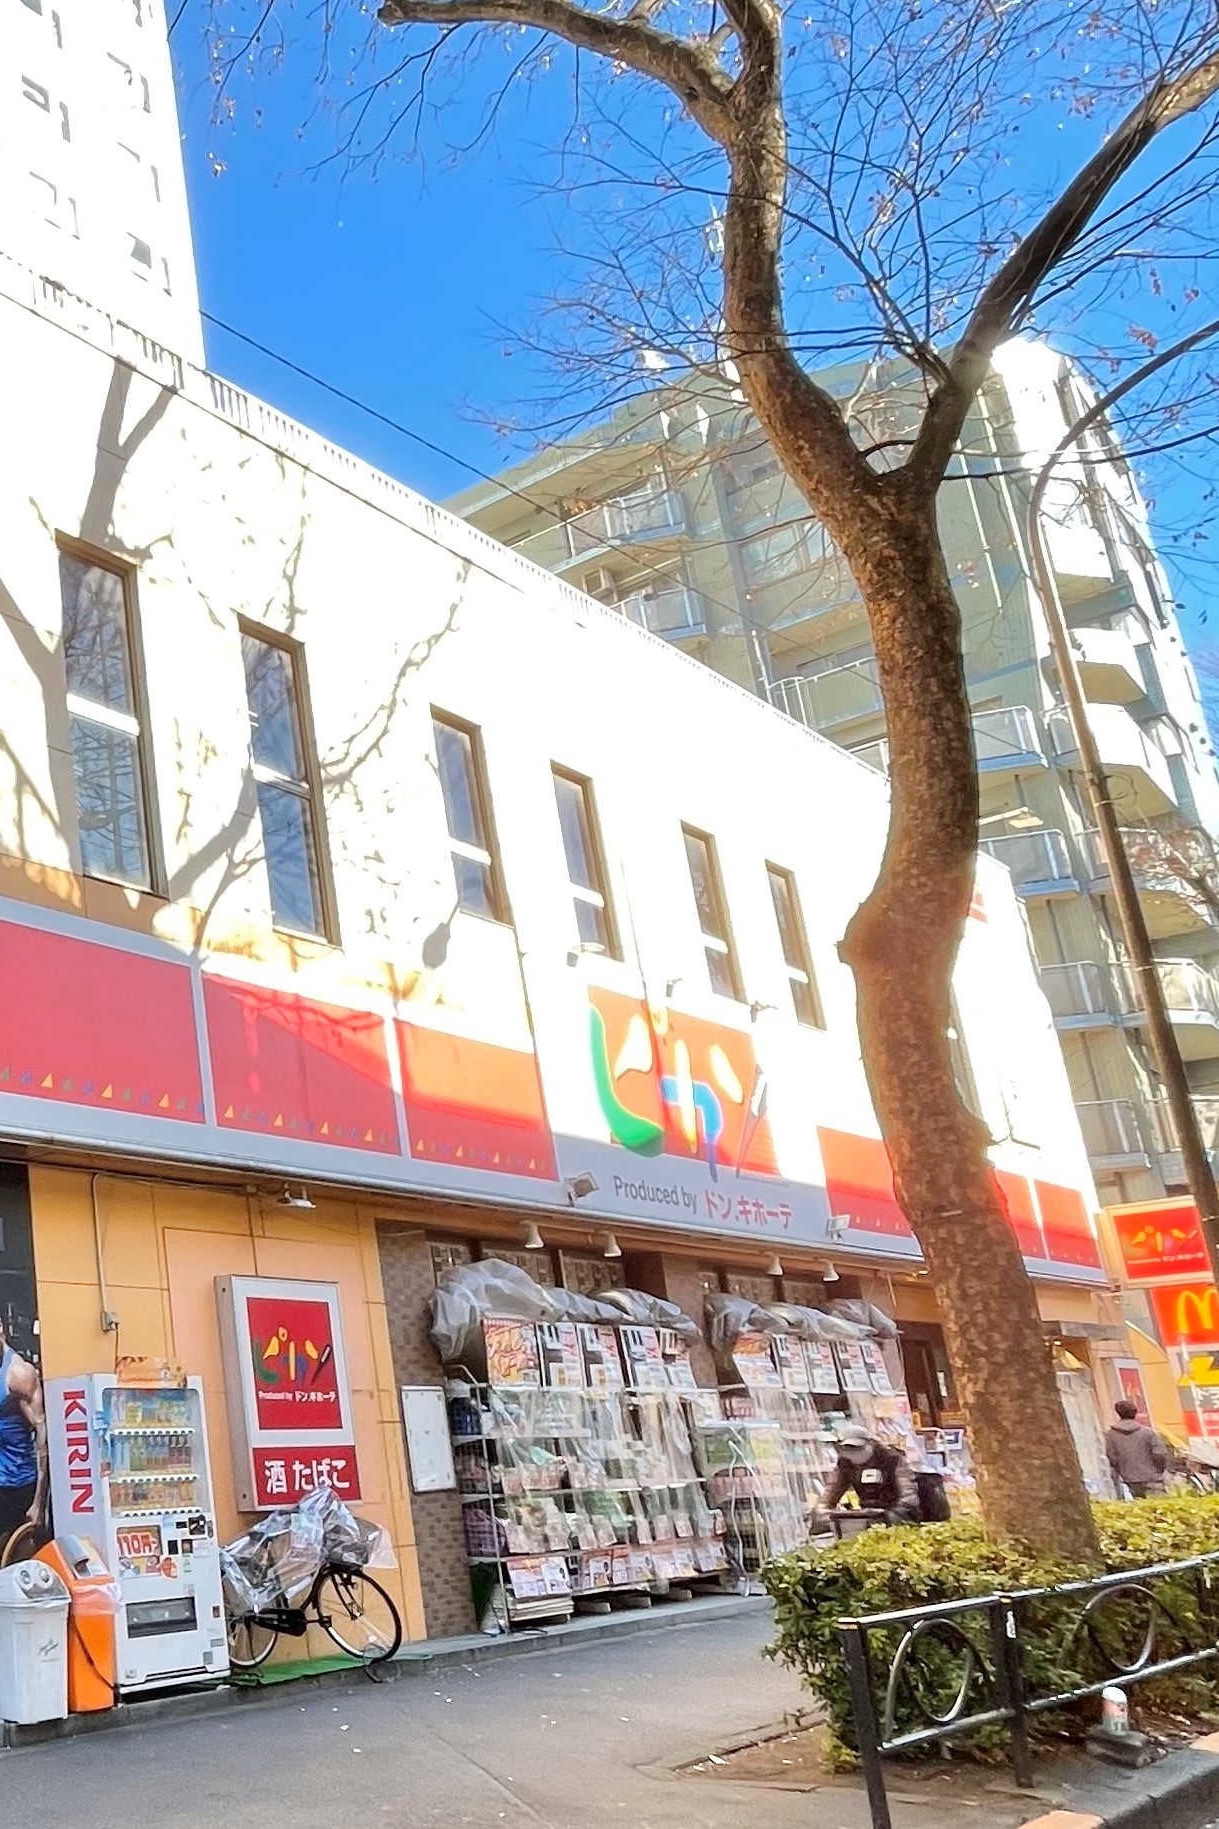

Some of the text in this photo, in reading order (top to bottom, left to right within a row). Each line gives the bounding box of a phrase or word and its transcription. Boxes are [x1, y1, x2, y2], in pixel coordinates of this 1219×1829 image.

[613, 1174, 697, 1215] Produced by
[63, 1390, 95, 1513] KIRIN
[264, 1457, 350, 1494] 酒 たばこ
